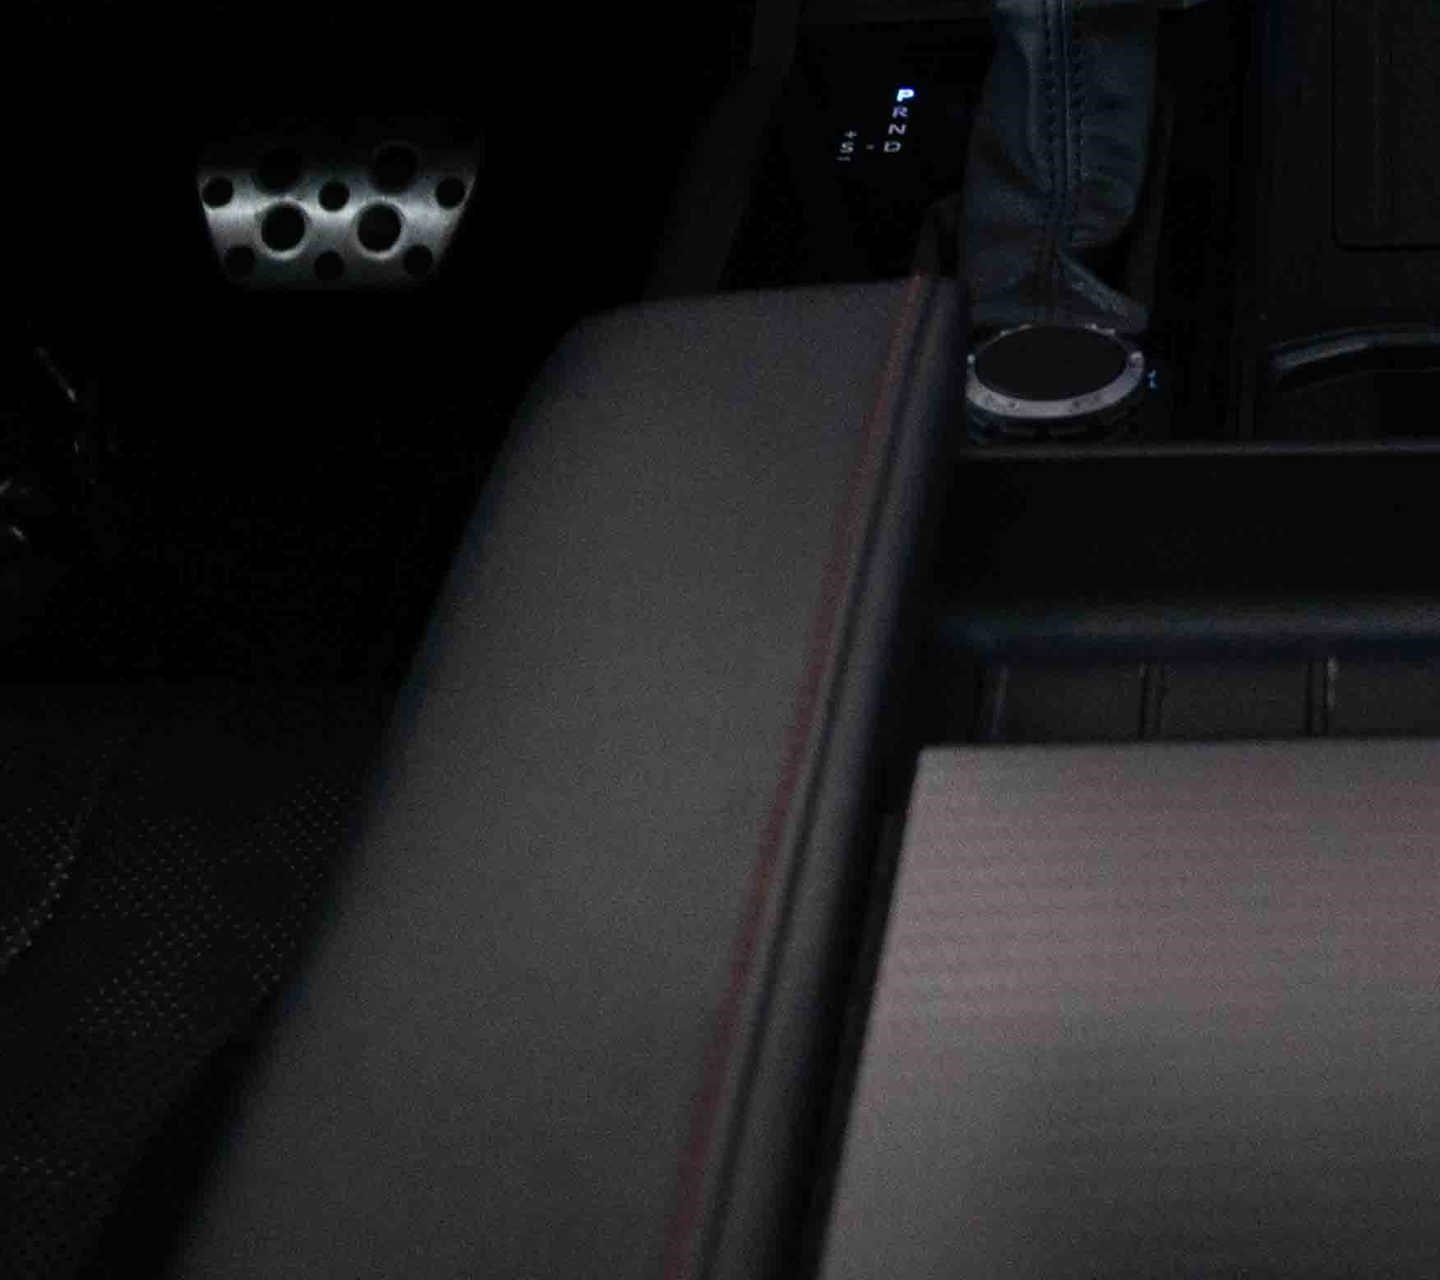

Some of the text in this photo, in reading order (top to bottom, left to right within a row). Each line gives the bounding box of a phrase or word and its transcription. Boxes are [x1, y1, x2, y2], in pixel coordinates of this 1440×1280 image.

[895, 87, 915, 103] P
[891, 106, 909, 119] R
[887, 123, 907, 136] N
